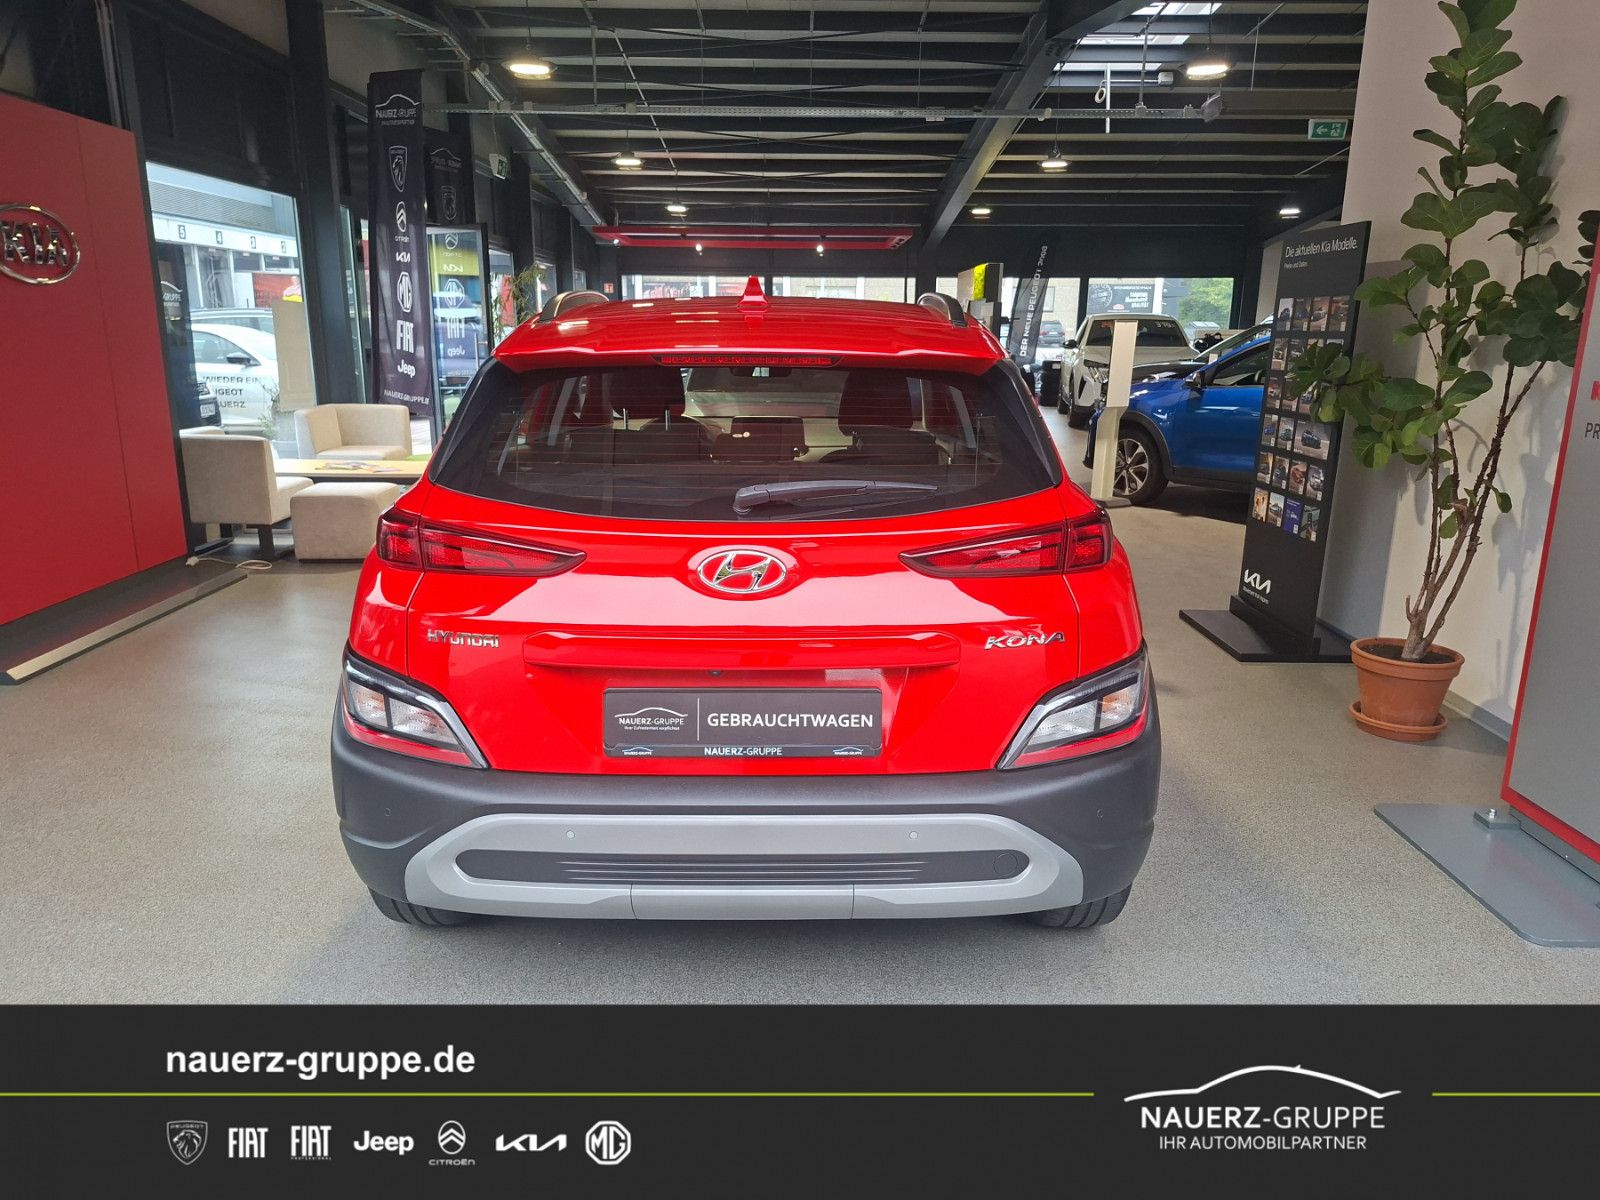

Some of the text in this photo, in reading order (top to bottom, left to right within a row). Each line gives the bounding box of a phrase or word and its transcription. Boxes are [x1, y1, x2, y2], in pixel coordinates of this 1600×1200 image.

[0, 220, 67, 267] KIA
[1023, 310, 1034, 337] NEUE
[396, 320, 414, 353] FIAT
[1019, 338, 1029, 357] DER
[397, 359, 416, 379] Jeep
[427, 629, 500, 648] HYUNDAI
[984, 632, 1065, 651] KONA
[618, 717, 684, 725] NAUERZ-GRUPPE
[707, 713, 873, 728] GEBRAUCHTWAGEN
[704, 747, 782, 755] NAUERZ-GRUPPE
